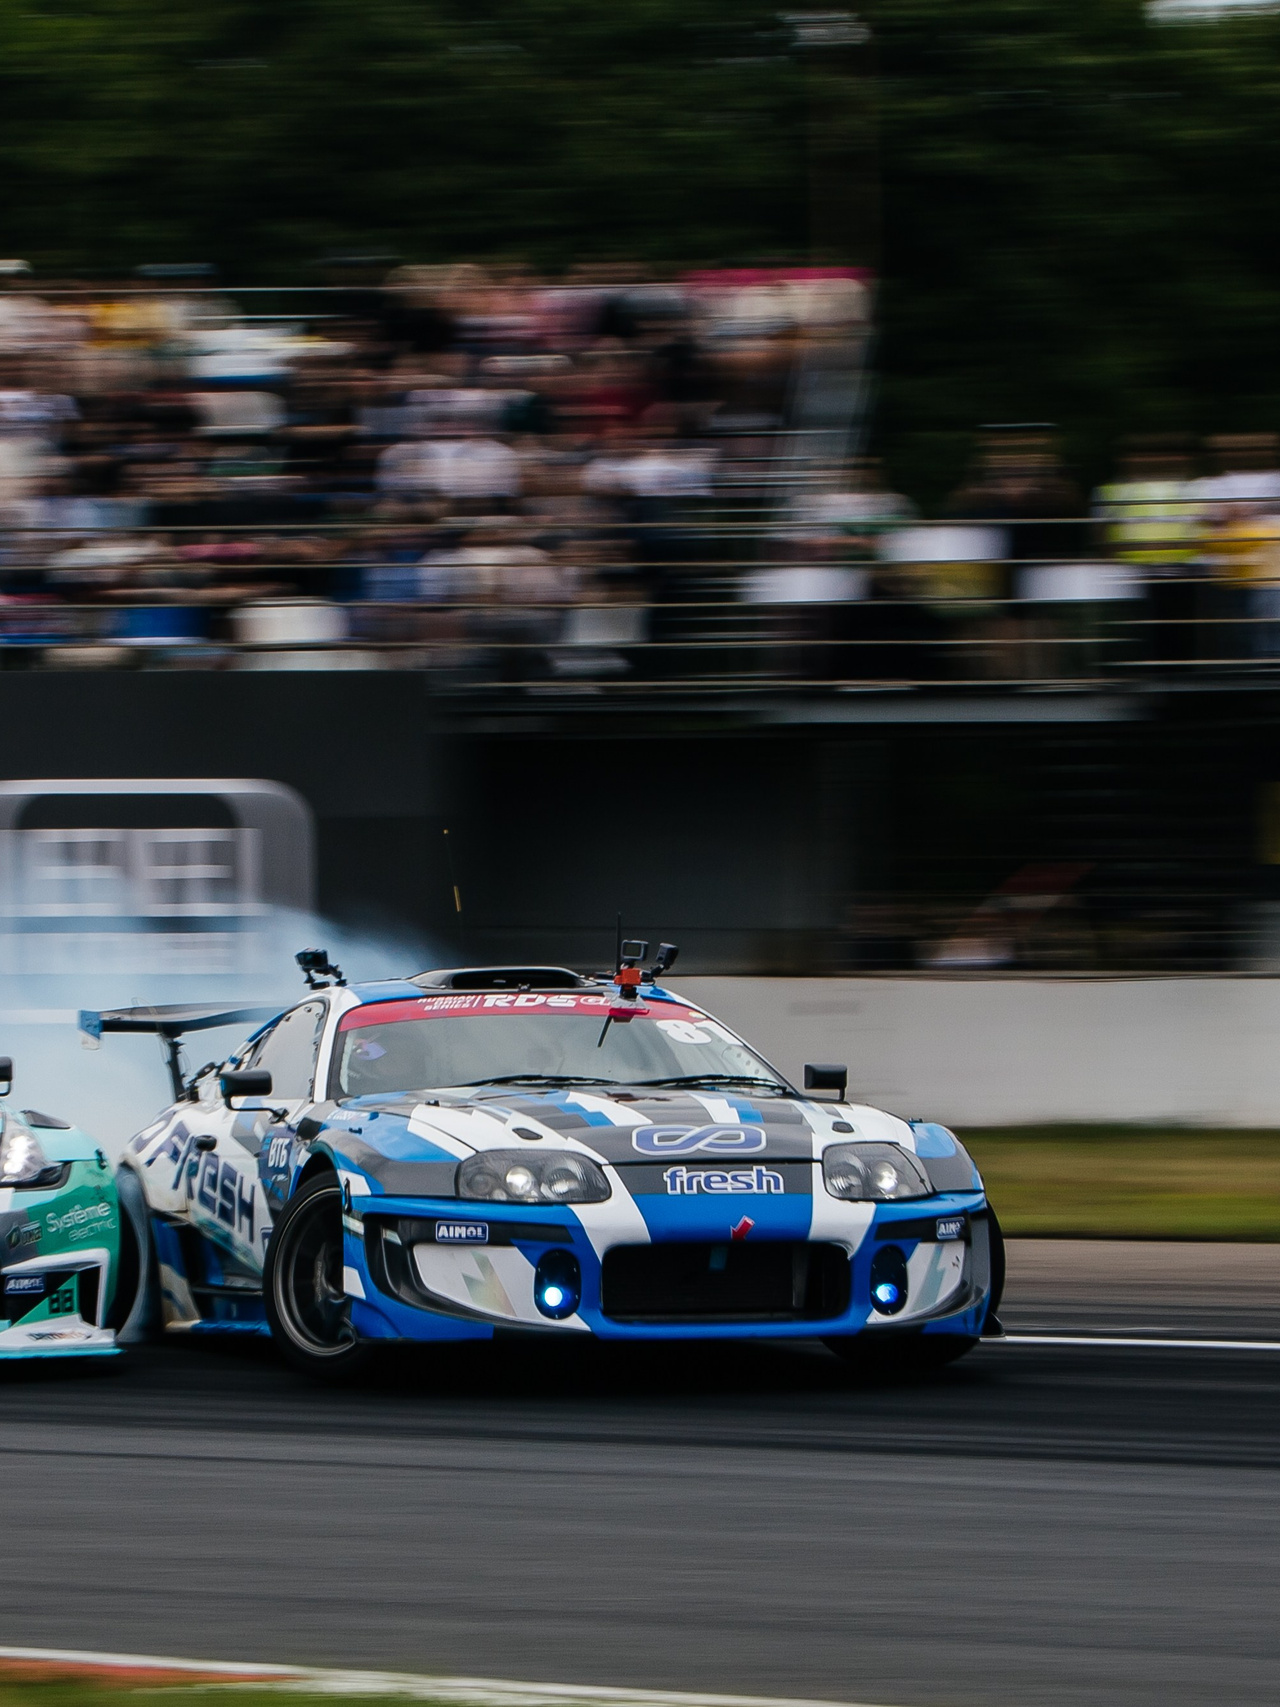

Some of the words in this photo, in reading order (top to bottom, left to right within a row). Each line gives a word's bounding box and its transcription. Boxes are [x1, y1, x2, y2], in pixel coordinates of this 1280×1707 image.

[483, 994, 578, 1007] RDS
[663, 1166, 784, 1195] fresh
[437, 1224, 486, 1238] AIMOL
